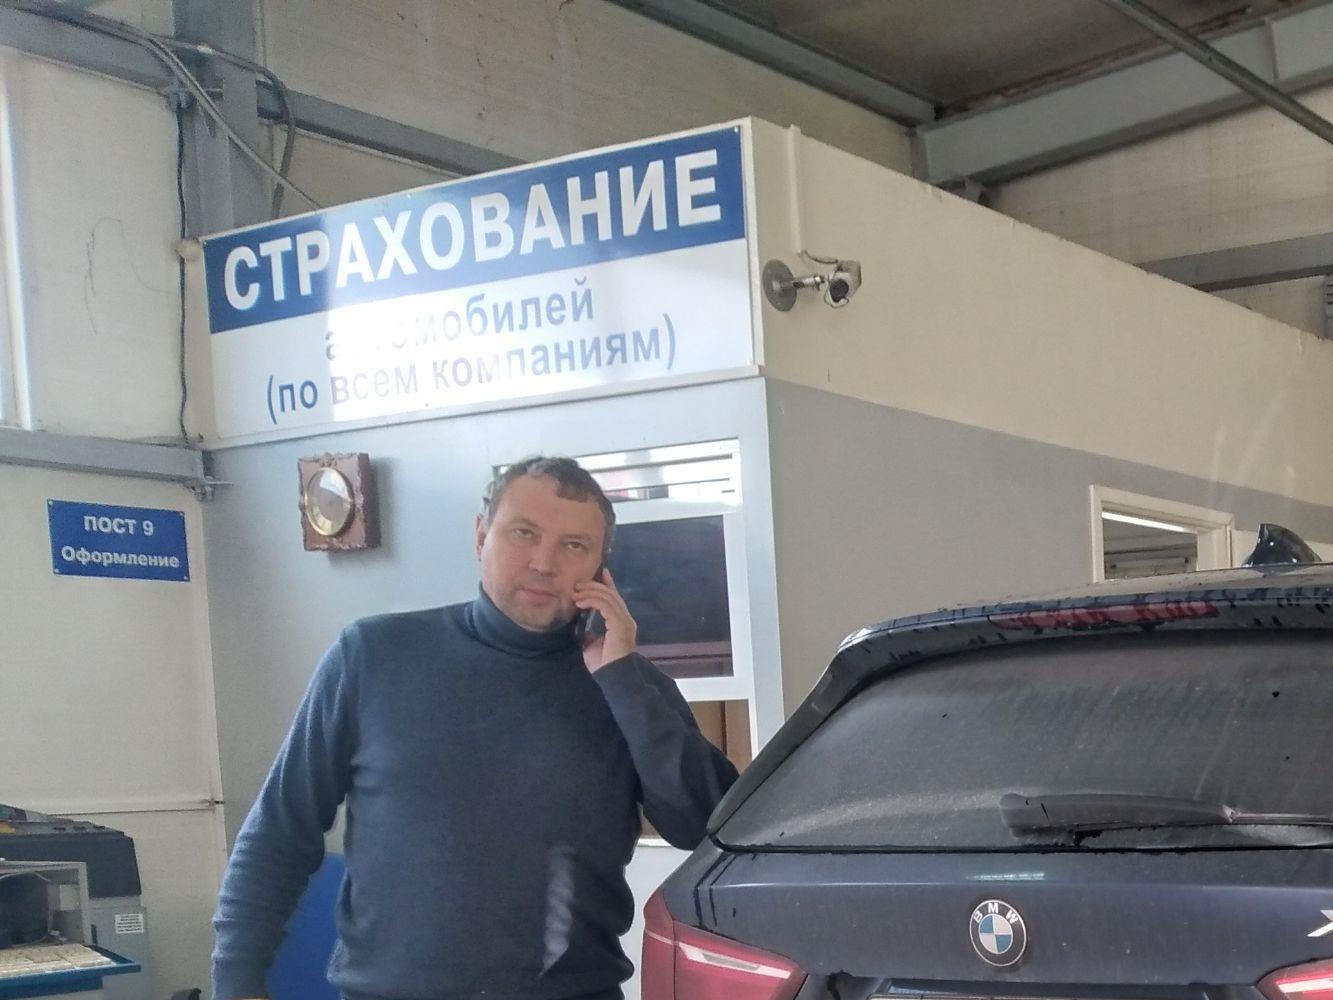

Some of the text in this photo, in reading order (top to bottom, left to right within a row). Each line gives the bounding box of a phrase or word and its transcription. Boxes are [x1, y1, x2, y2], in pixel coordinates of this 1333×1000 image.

[223, 148, 723, 312] СТРАХОВАНИЕ
[267, 313, 677, 424] (по всем компаниям)
[83, 515, 155, 537] ПОСТ 9
[61, 545, 180, 568] Оформление
[973, 902, 1019, 924] BMW
